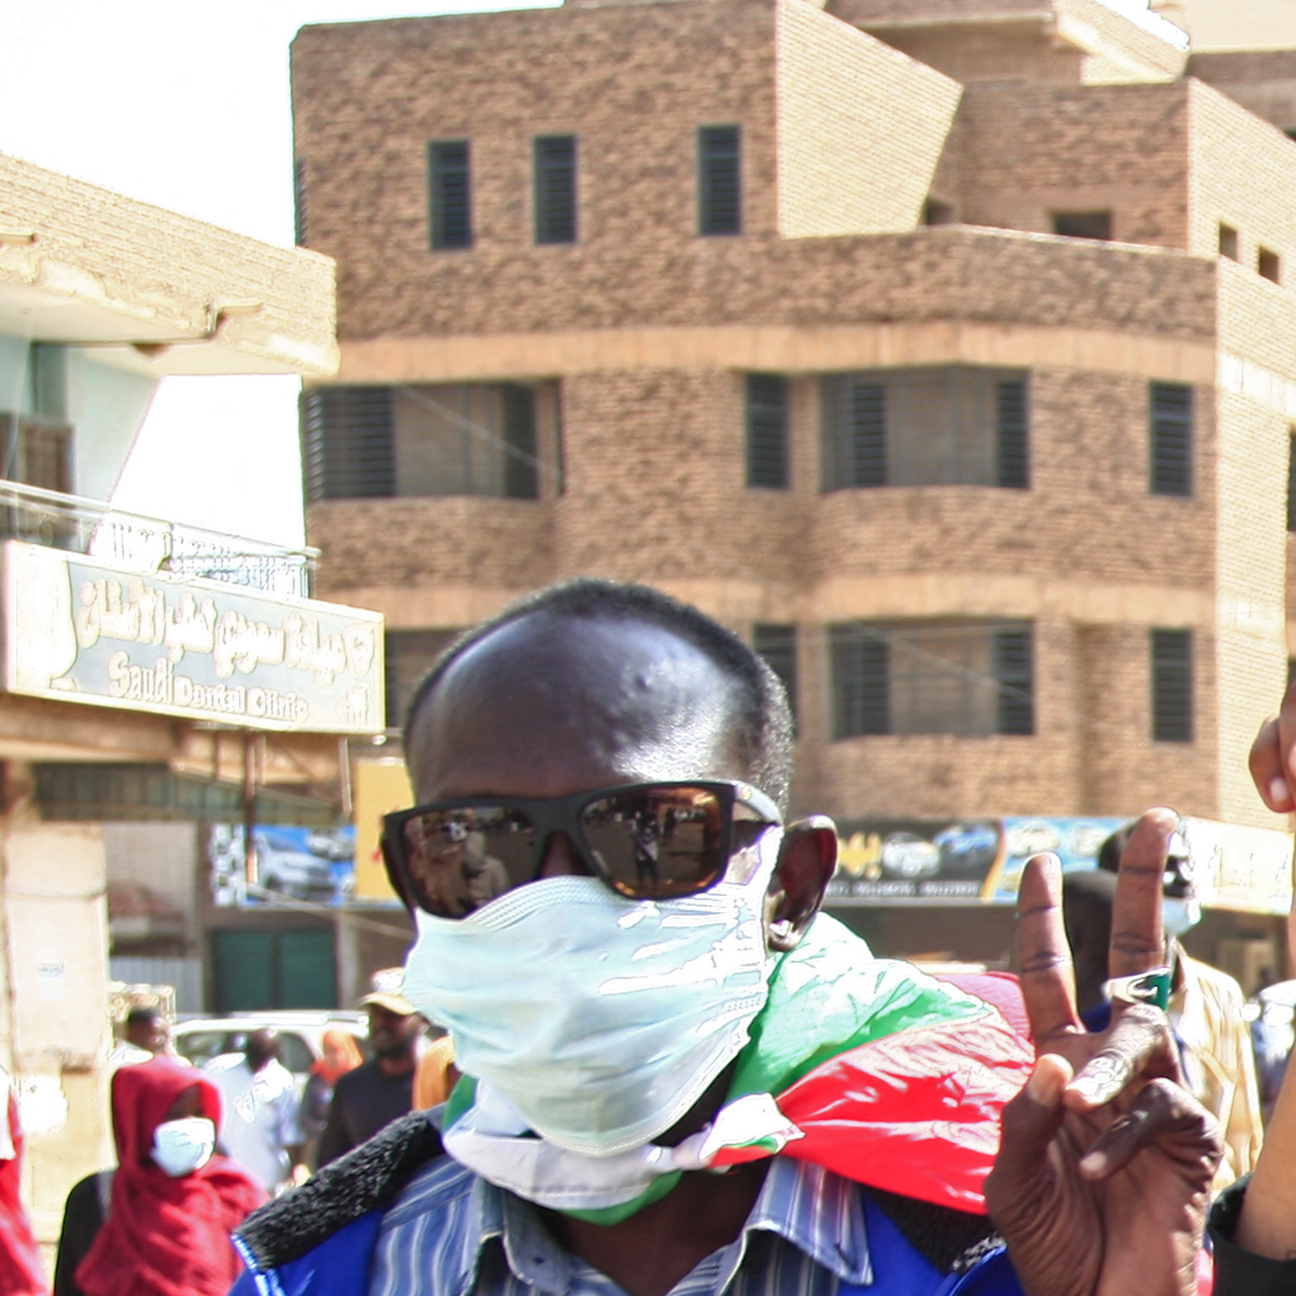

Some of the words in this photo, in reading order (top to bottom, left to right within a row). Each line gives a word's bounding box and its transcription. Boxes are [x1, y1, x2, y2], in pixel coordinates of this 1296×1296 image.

[108, 652, 174, 706] Saudi
[175, 676, 246, 716] Dental
[247, 687, 310, 724] Clinic
